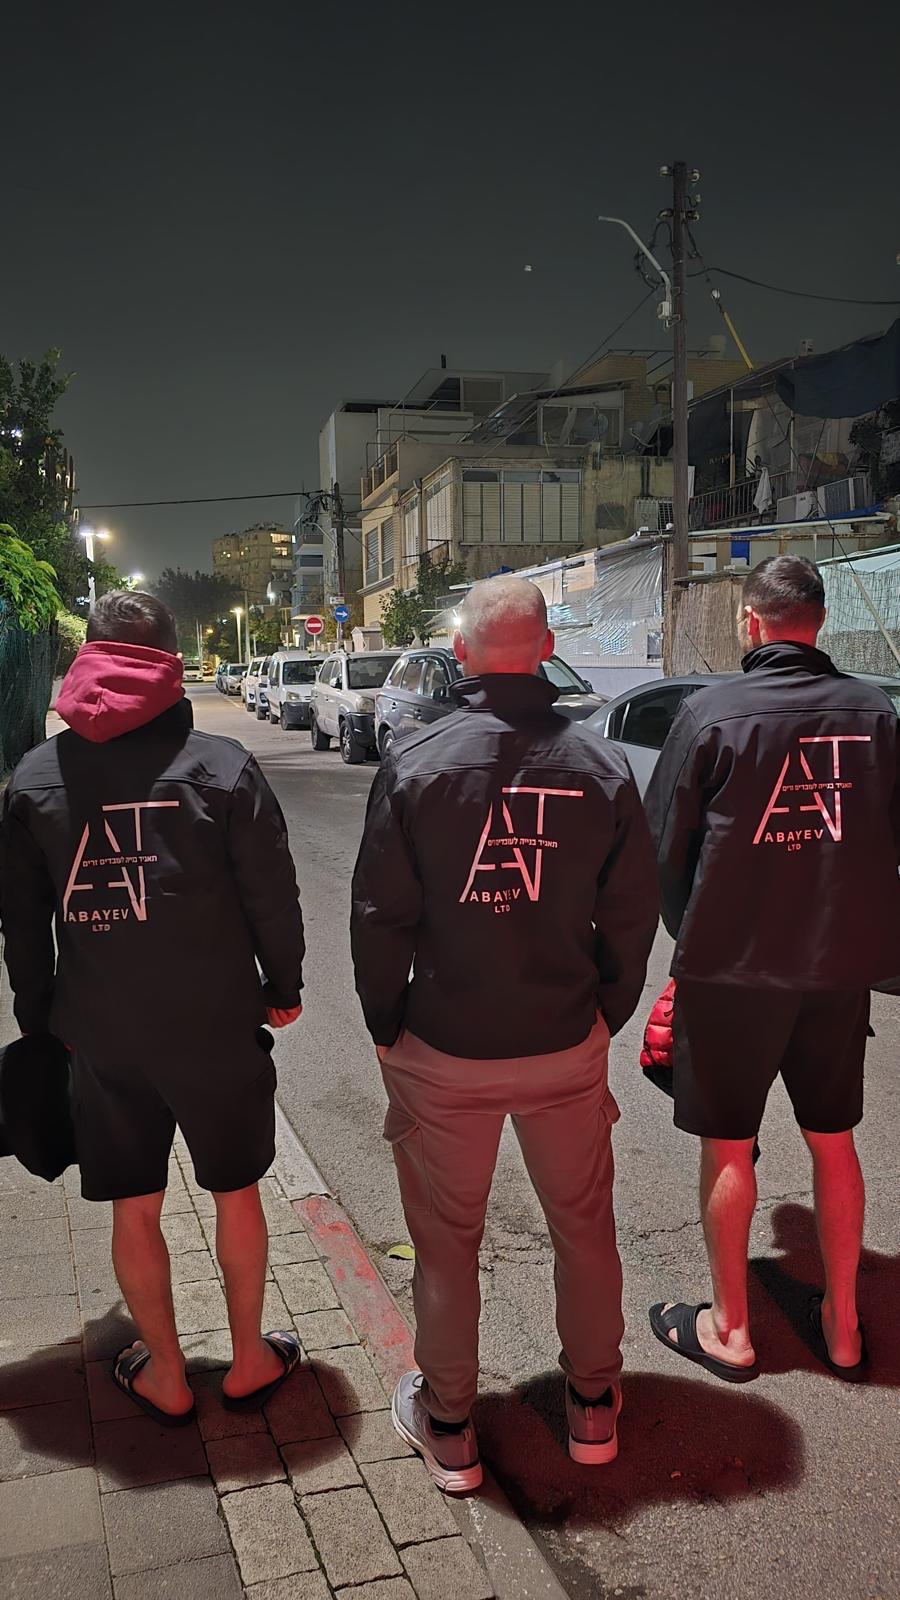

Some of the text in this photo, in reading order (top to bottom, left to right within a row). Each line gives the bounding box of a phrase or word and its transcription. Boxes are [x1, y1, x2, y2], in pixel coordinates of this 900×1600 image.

[764, 829, 824, 843] ABAYEV
[538, 839, 558, 848] תאגיד
[787, 843, 801, 851] LTD
[469, 888, 521, 903] ABAYEV
[494, 904, 511, 913] LTD
[68, 908, 129, 922] ABAYEV
[92, 924, 111, 932] LTD
